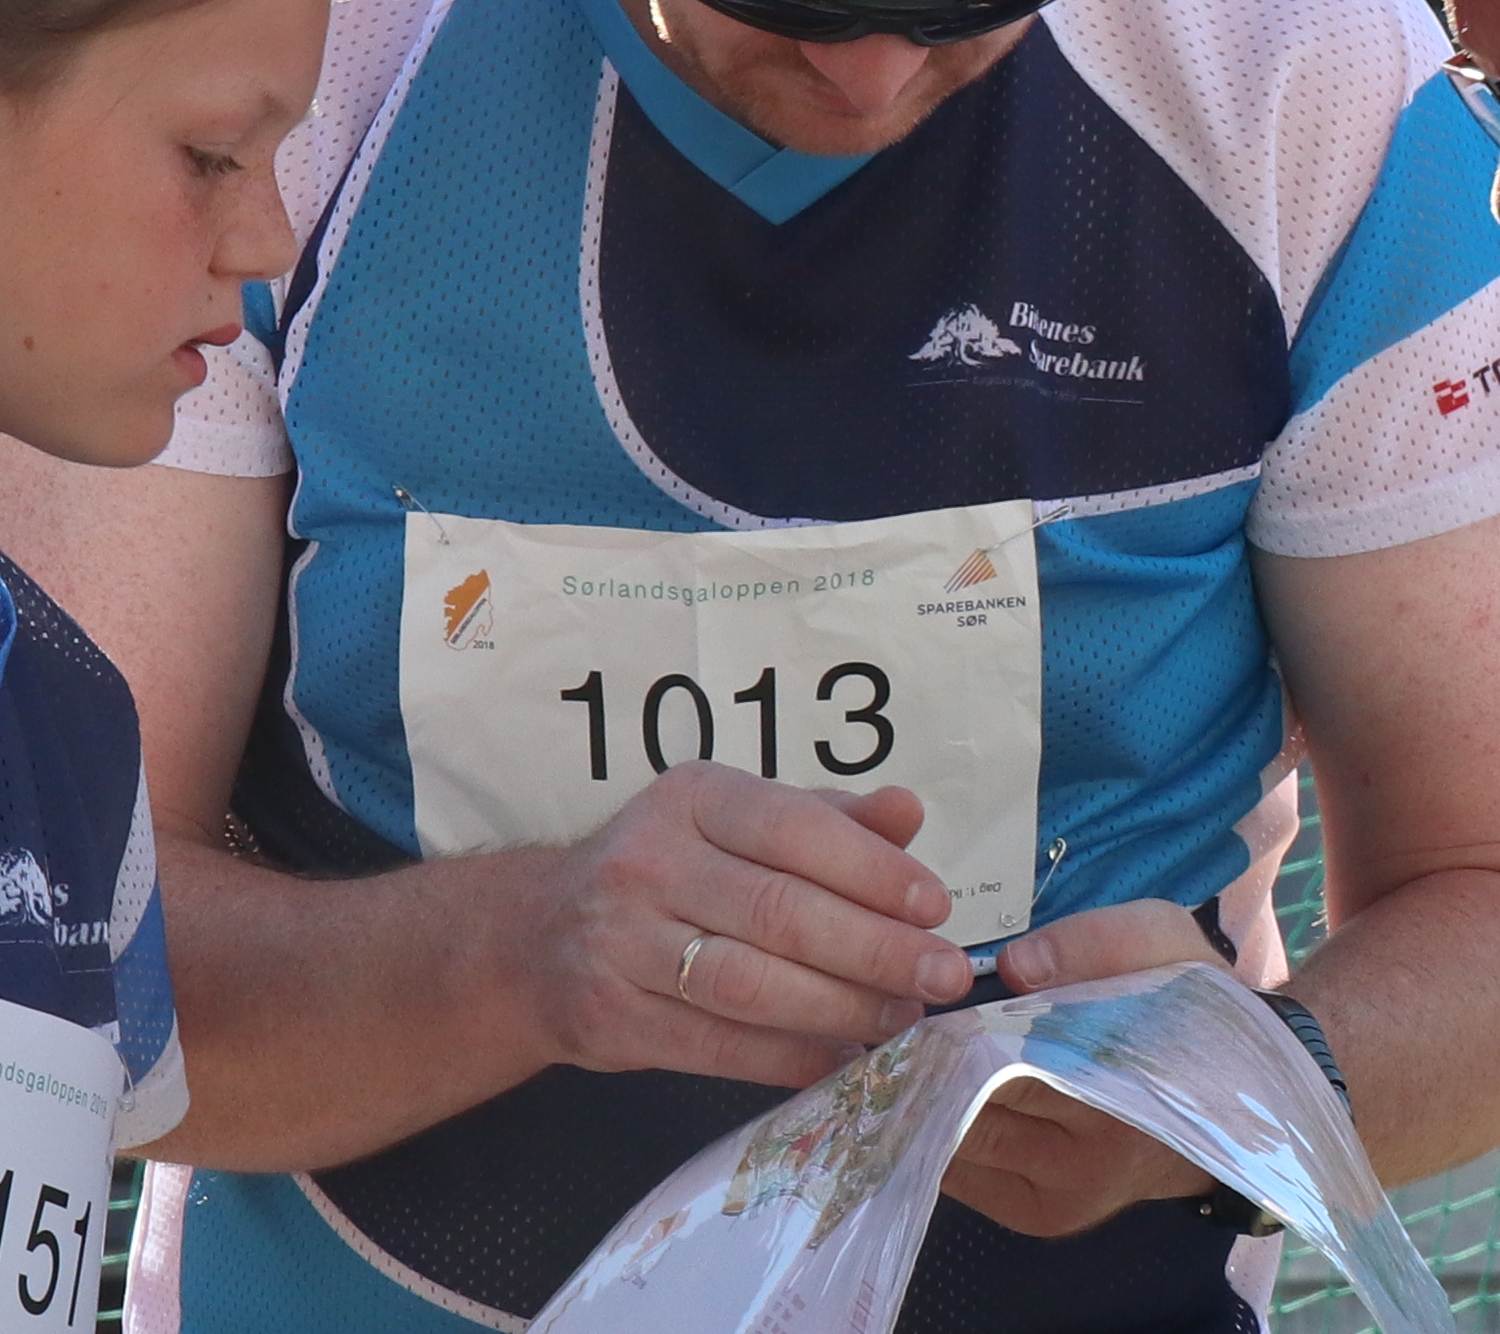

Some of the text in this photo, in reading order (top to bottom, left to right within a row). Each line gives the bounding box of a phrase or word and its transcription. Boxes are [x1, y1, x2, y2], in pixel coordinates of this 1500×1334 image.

[561, 569, 876, 607] Sørlandsgaloppen 2018
[916, 595, 1027, 616] SPAREBANKEN
[956, 614, 988, 627] SØR
[559, 661, 896, 782] 1013
[979, 881, 1002, 893] Dag
